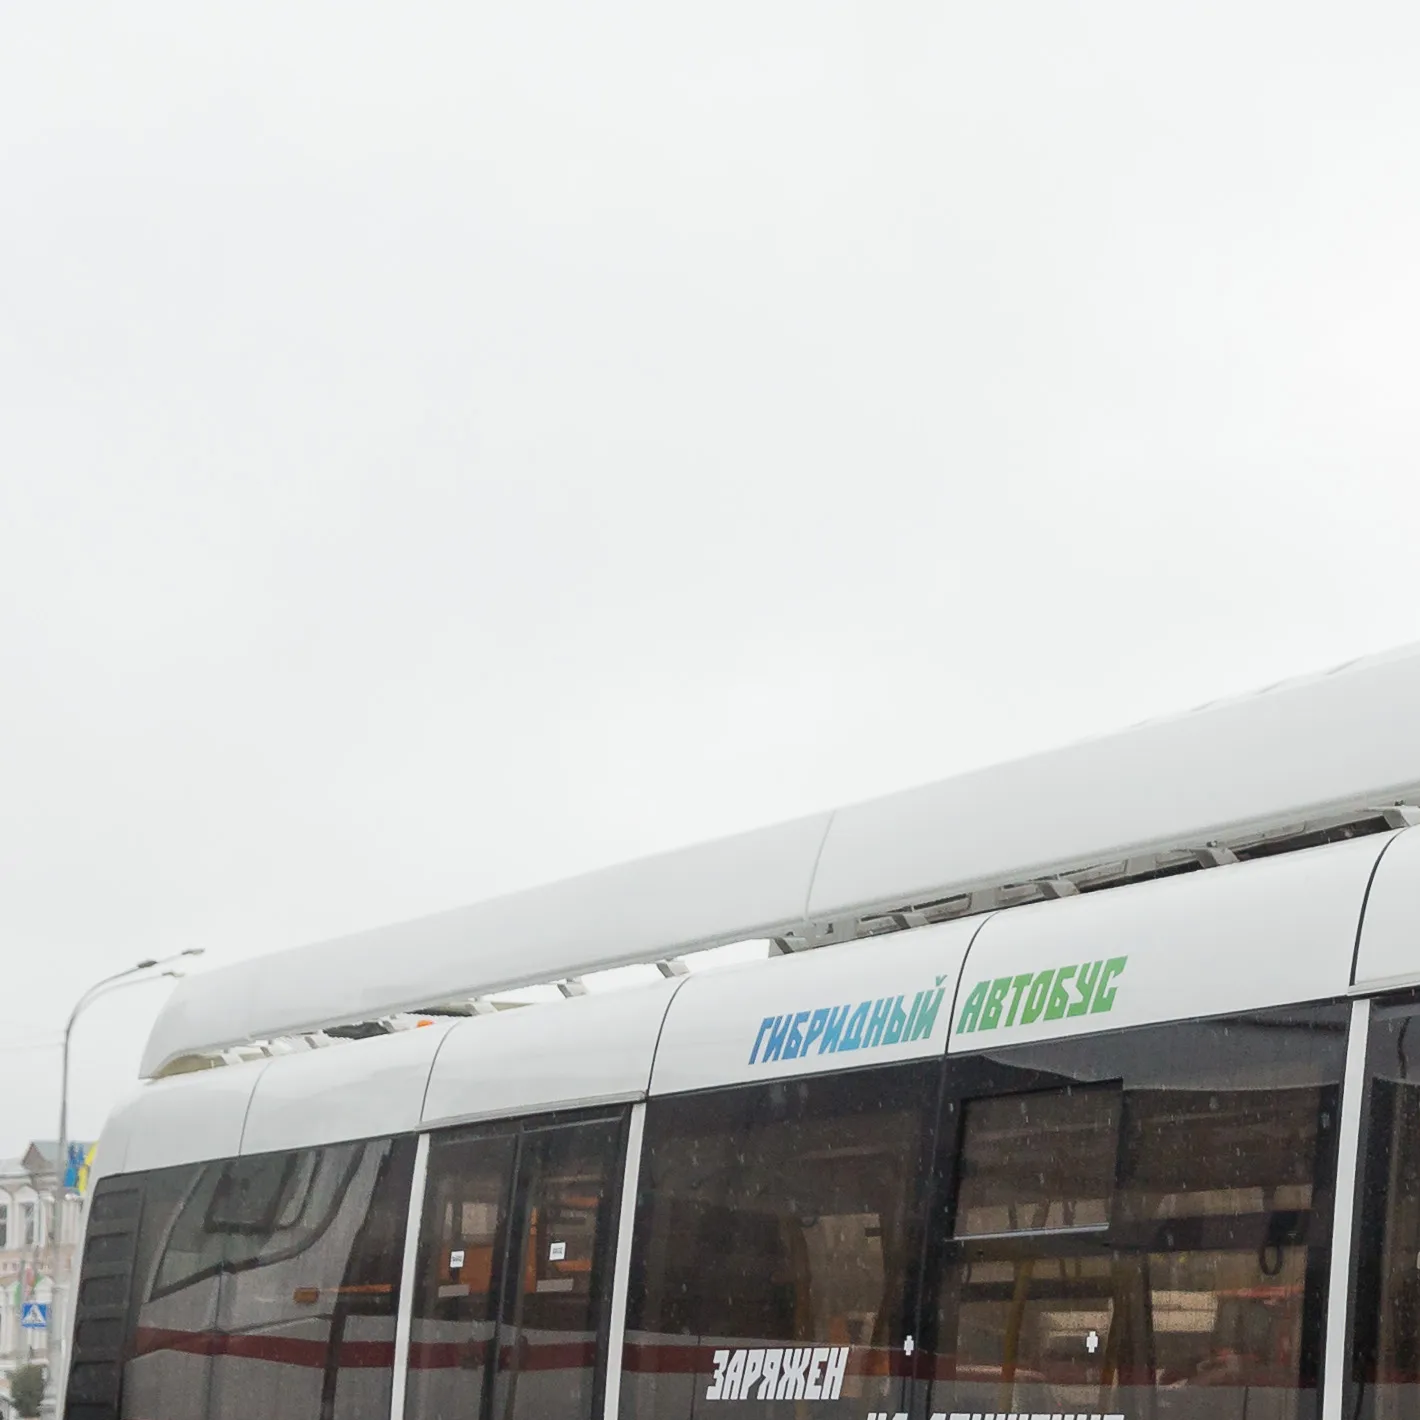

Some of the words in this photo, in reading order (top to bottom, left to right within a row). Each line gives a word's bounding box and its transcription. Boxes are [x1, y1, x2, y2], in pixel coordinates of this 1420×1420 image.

[748, 974, 947, 1065] ГИБРИДНЫЙ
[956, 955, 1128, 1034] АВТОБУС
[706, 1347, 849, 1401] ЗАРЯЖЕН
